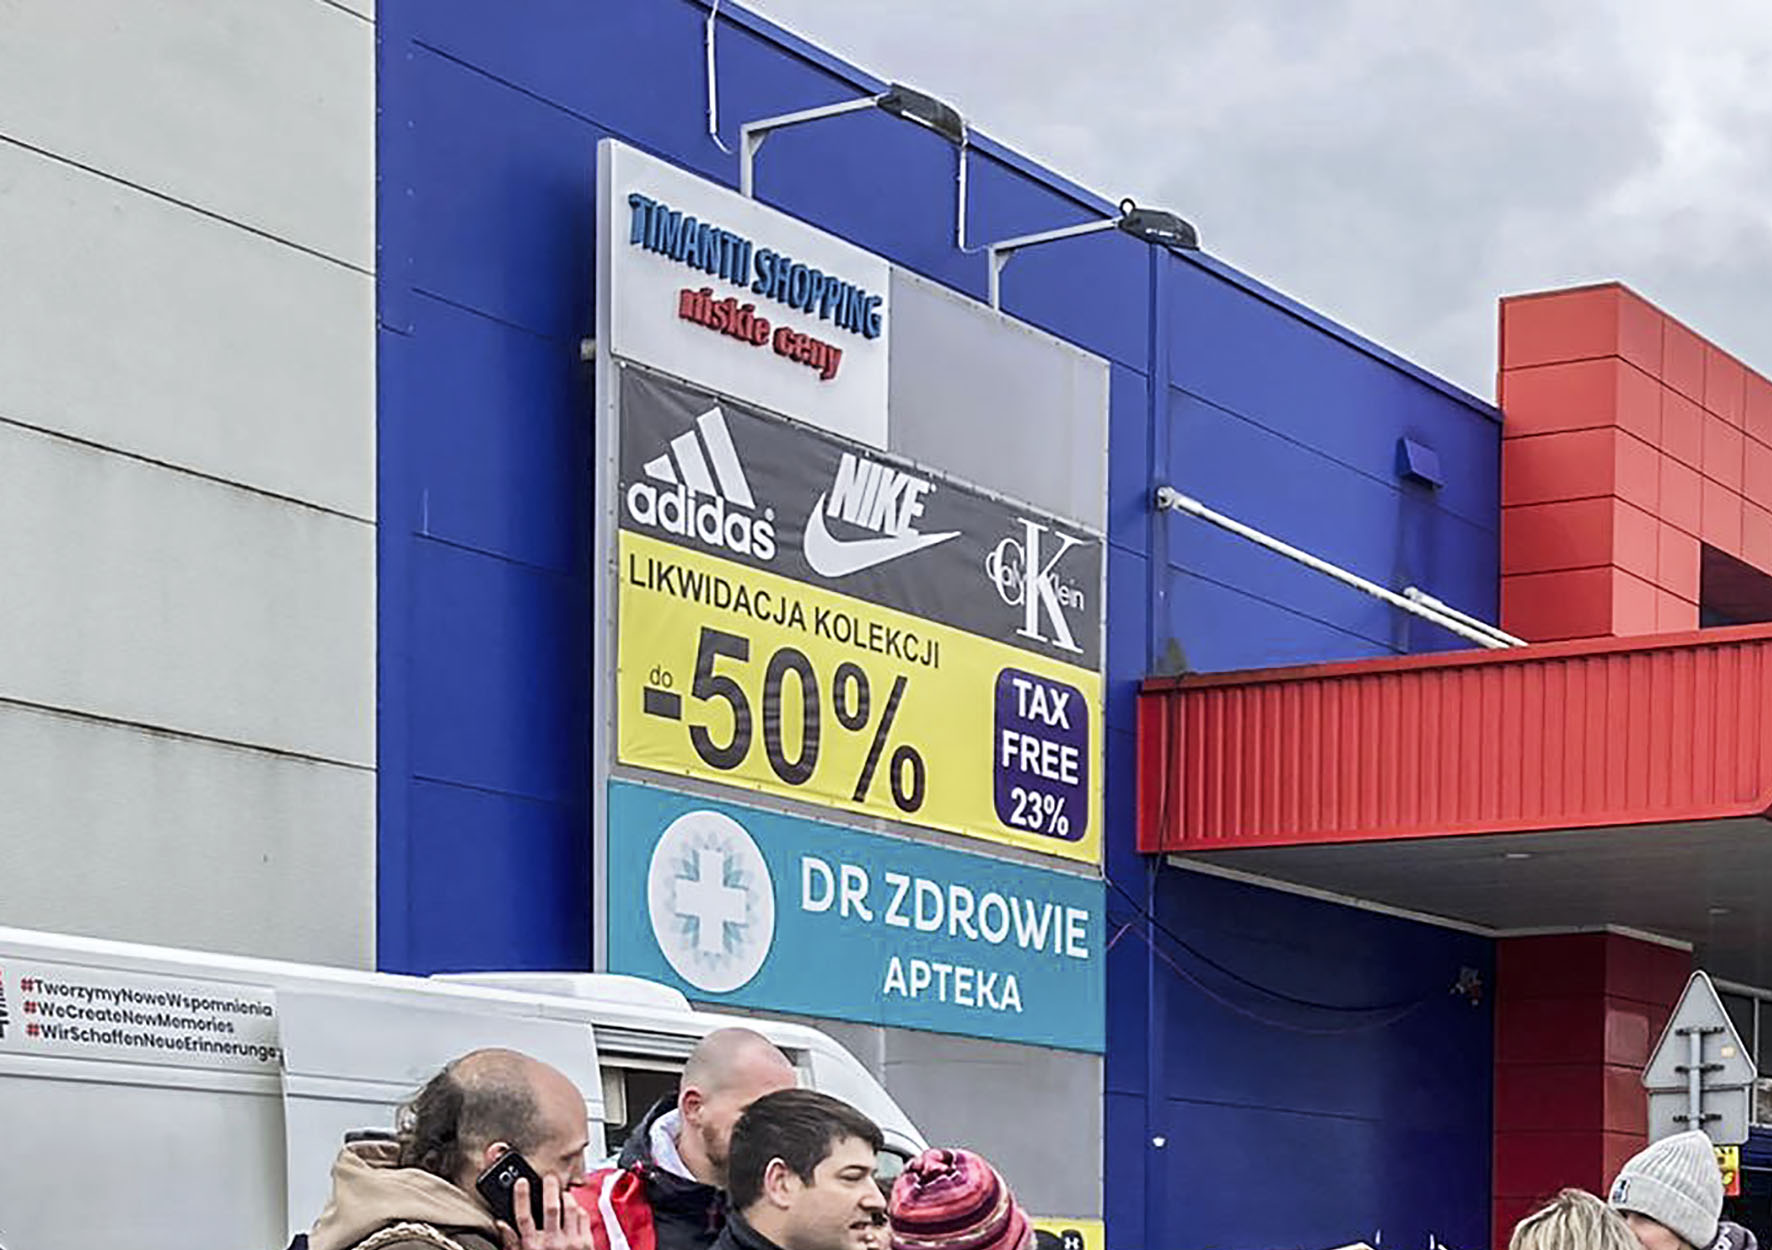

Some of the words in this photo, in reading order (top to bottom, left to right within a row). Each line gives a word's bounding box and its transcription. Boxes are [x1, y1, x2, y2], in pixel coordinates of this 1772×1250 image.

[752, 248, 883, 339] SHOPPING
[678, 287, 770, 346] niskie
[772, 327, 843, 380] ceny
[627, 482, 777, 561] adidas
[827, 452, 929, 537] NIKE
[630, 553, 807, 632] LIKWIDACJA
[814, 606, 940, 670] KOLEKCJI
[649, 664, 673, 689] do
[1013, 677, 1070, 730] TAX
[643, 626, 926, 813] -50%
[1002, 729, 1080, 785] FREE
[1010, 787, 1069, 837] 23%
[801, 857, 873, 922] DR
[885, 873, 1090, 959] ZDROWIE
[21, 977, 273, 1018] #TworzymyNoweWspomnienia
[24, 1000, 235, 1034] #WeCreateNewMemories
[883, 955, 1024, 1012] APTEKA
